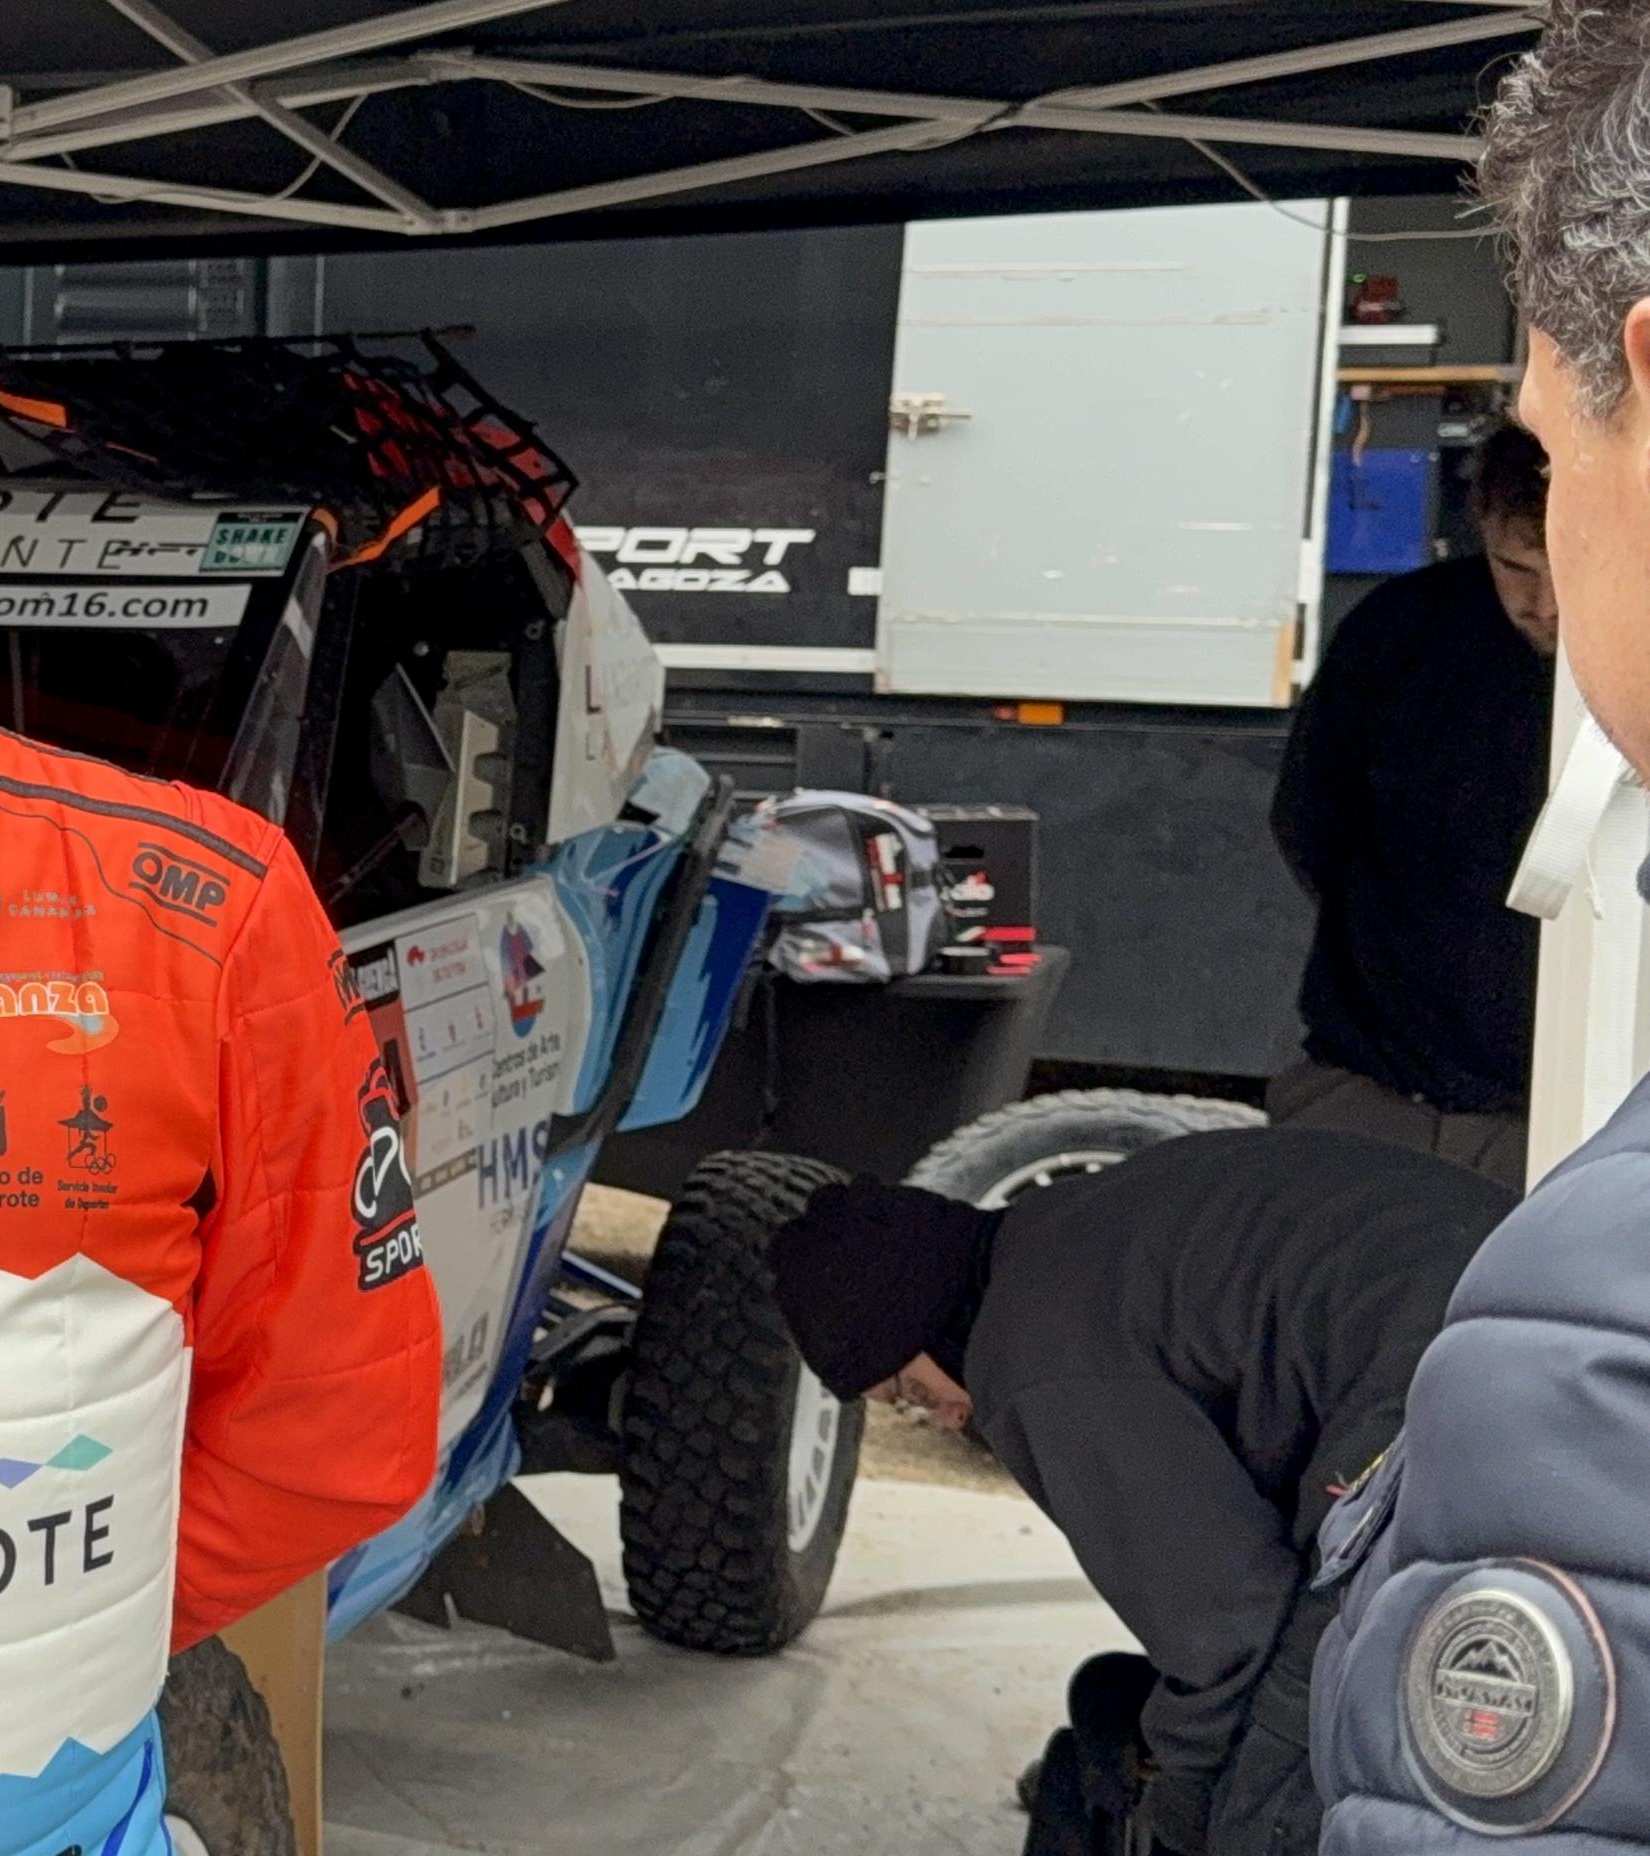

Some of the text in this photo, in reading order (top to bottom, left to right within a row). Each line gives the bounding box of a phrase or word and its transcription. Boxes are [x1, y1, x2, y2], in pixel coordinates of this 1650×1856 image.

[215, 528, 288, 545] SHAKE
[132, 851, 226, 911] OMP
[17, 1167, 44, 1186] de
[354, 1126, 412, 1218] CD
